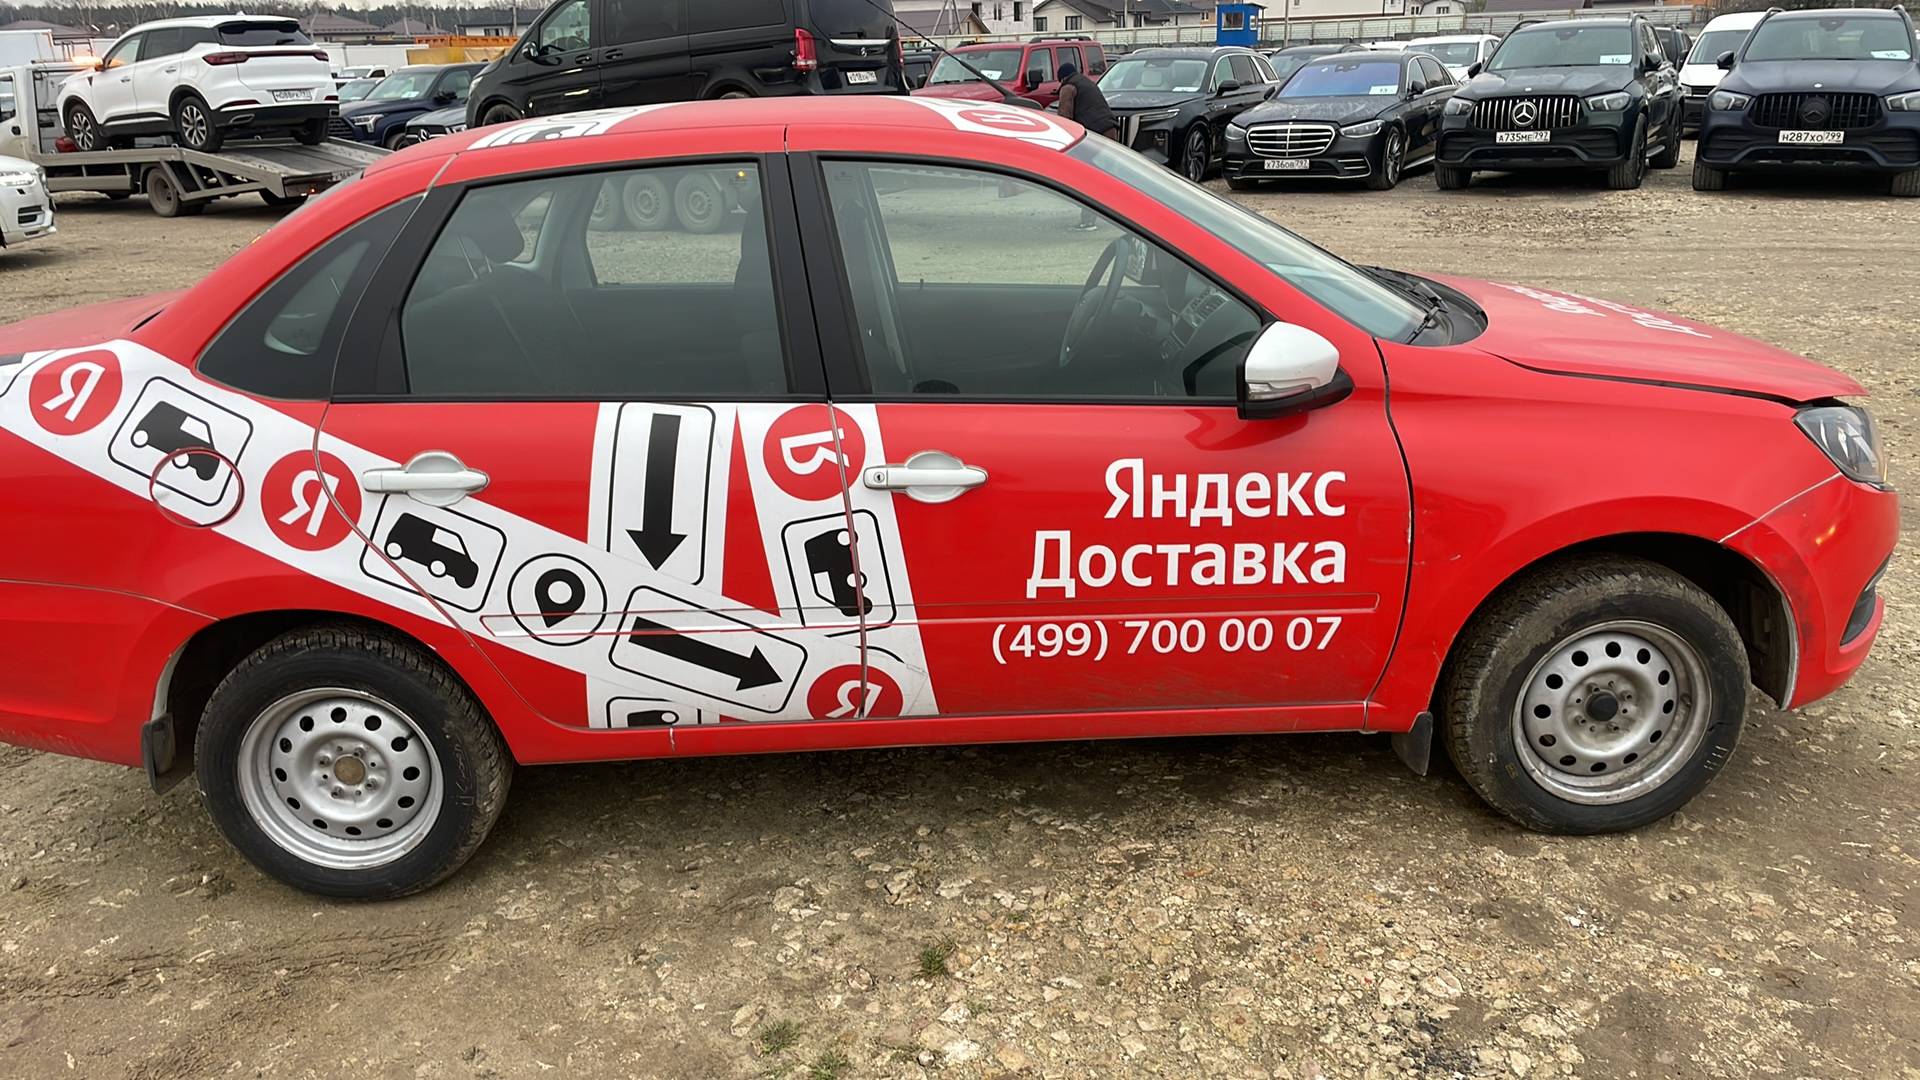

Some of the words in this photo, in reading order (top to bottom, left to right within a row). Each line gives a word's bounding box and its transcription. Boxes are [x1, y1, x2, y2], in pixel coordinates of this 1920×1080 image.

[42, 361, 105, 422] Я
[278, 469, 340, 537] Я
[1104, 457, 1346, 527] Яндекс
[1026, 529, 1346, 599] Доставка
[992, 620, 1108, 665] (499)
[1124, 619, 1206, 654] 700
[1219, 617, 1274, 652] 00
[1286, 616, 1342, 651] 07
